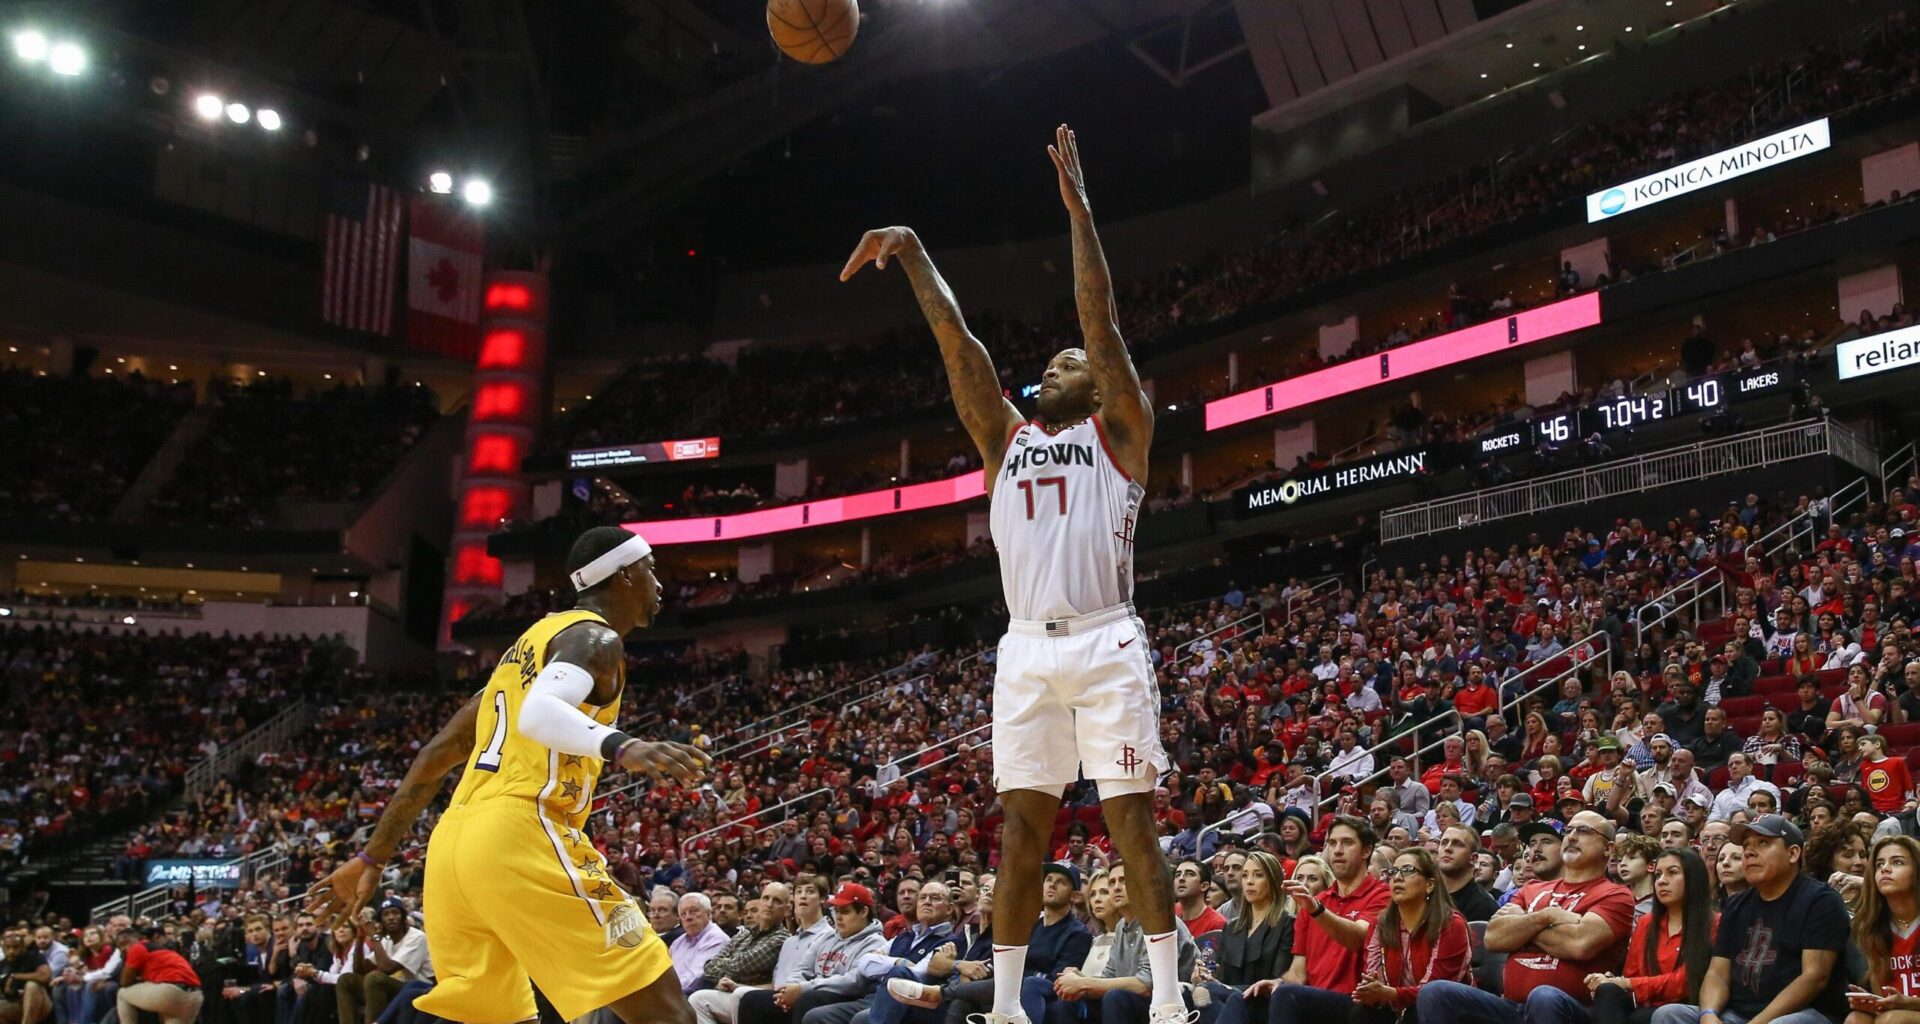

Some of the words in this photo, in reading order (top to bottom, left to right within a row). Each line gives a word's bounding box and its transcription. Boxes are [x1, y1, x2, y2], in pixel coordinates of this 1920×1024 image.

[1634, 166, 1713, 201] KONICA
[1719, 133, 1814, 175] MINOLTA
[1688, 380, 1719, 408] 40
[1740, 372, 1779, 392] LAKERS
[1598, 397, 1647, 429] 7:04
[1652, 399, 1663, 419] 2
[1482, 433, 1520, 452] ROCKETS
[1541, 415, 1569, 442] 46
[1248, 475, 1331, 508] MEMORIAL
[1336, 453, 1424, 488] HERMANN
[1017, 475, 1067, 521] 17
[474, 690, 508, 773] 1
